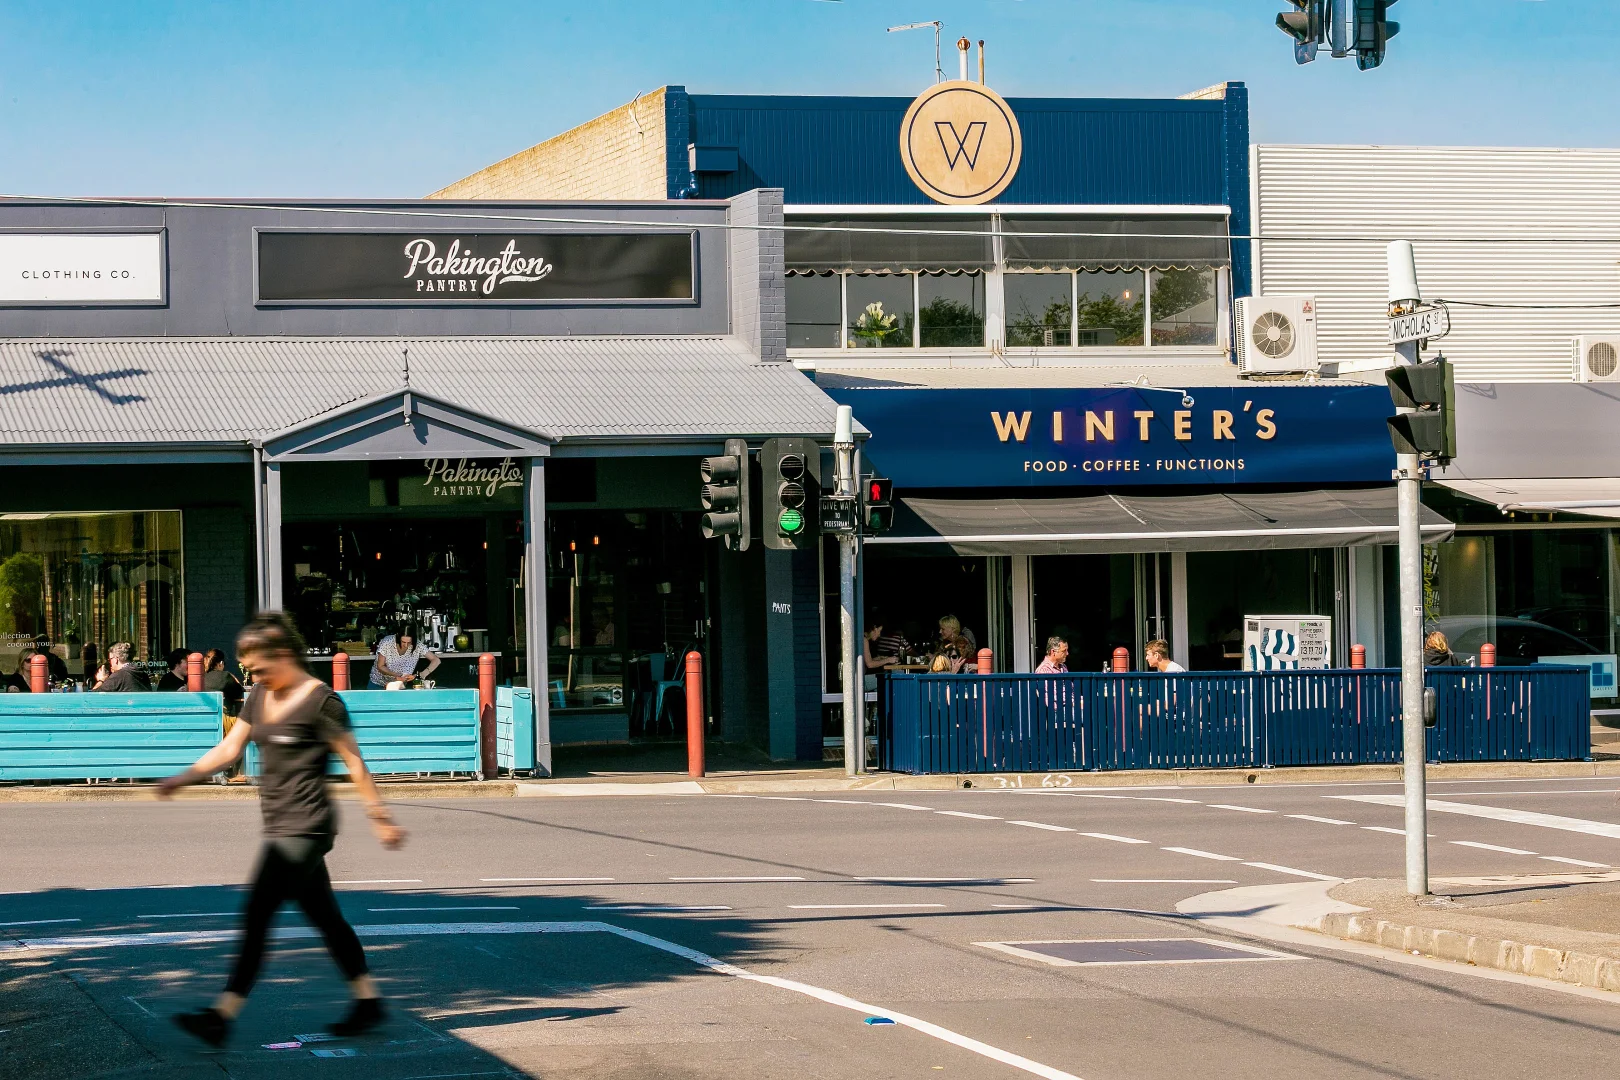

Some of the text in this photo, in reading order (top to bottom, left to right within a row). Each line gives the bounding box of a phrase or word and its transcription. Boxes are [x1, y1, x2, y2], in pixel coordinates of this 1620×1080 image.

[934, 121, 987, 171] W
[404, 238, 553, 295] Pakington
[21, 270, 136, 279] CLOTHING CO.
[416, 279, 478, 292] PANTRY
[1393, 313, 1431, 340] NICHOLAS
[990, 400, 1277, 442] WINTER'S
[1024, 458, 1246, 472] FOOD COFFEE FUNCTIONS
[423, 456, 524, 497] Pakingto
[433, 485, 482, 496] PANTRY
[823, 501, 850, 510] GIVE WA
[0, 631, 31, 640] ollection
